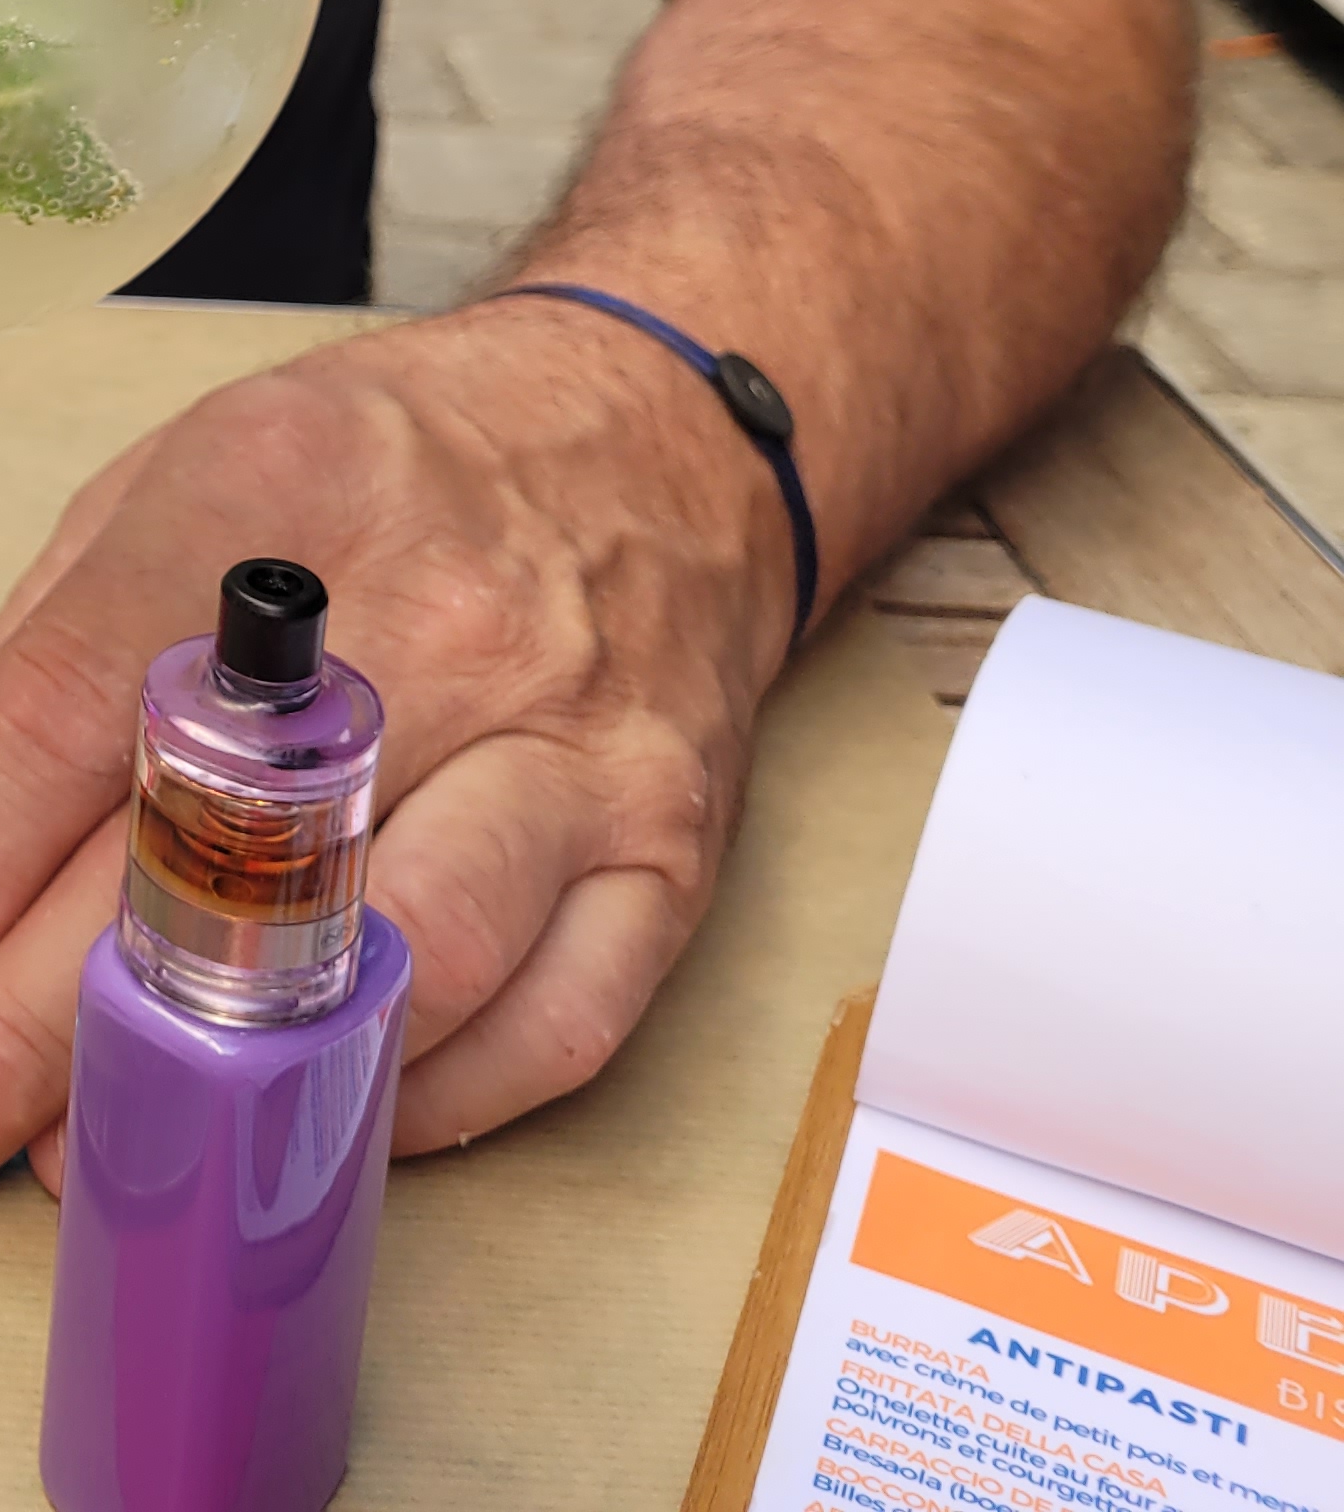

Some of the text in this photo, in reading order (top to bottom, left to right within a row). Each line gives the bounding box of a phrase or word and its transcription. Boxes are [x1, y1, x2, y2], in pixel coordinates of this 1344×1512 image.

[850, 1319, 990, 1383] BURRATA
[967, 1328, 1248, 1446] ANTIPASTI
[822, 1433, 943, 1492] Bresaola
[825, 1417, 1053, 1512] CARPACCIO DE
[831, 1394, 952, 1451] poivrons
[958, 1443, 987, 1464] et
[836, 1377, 1158, 1511] Omelette cuite au four
[840, 1359, 1168, 1499] FRITTATA DELLA CASA
[845, 1337, 909, 1369] avec
[914, 1362, 1005, 1406] crème
[1010, 1399, 1048, 1422] de
[1053, 1415, 1121, 1451] petit
[1127, 1443, 1187, 1476] pois
[1192, 1468, 1224, 1490] et
